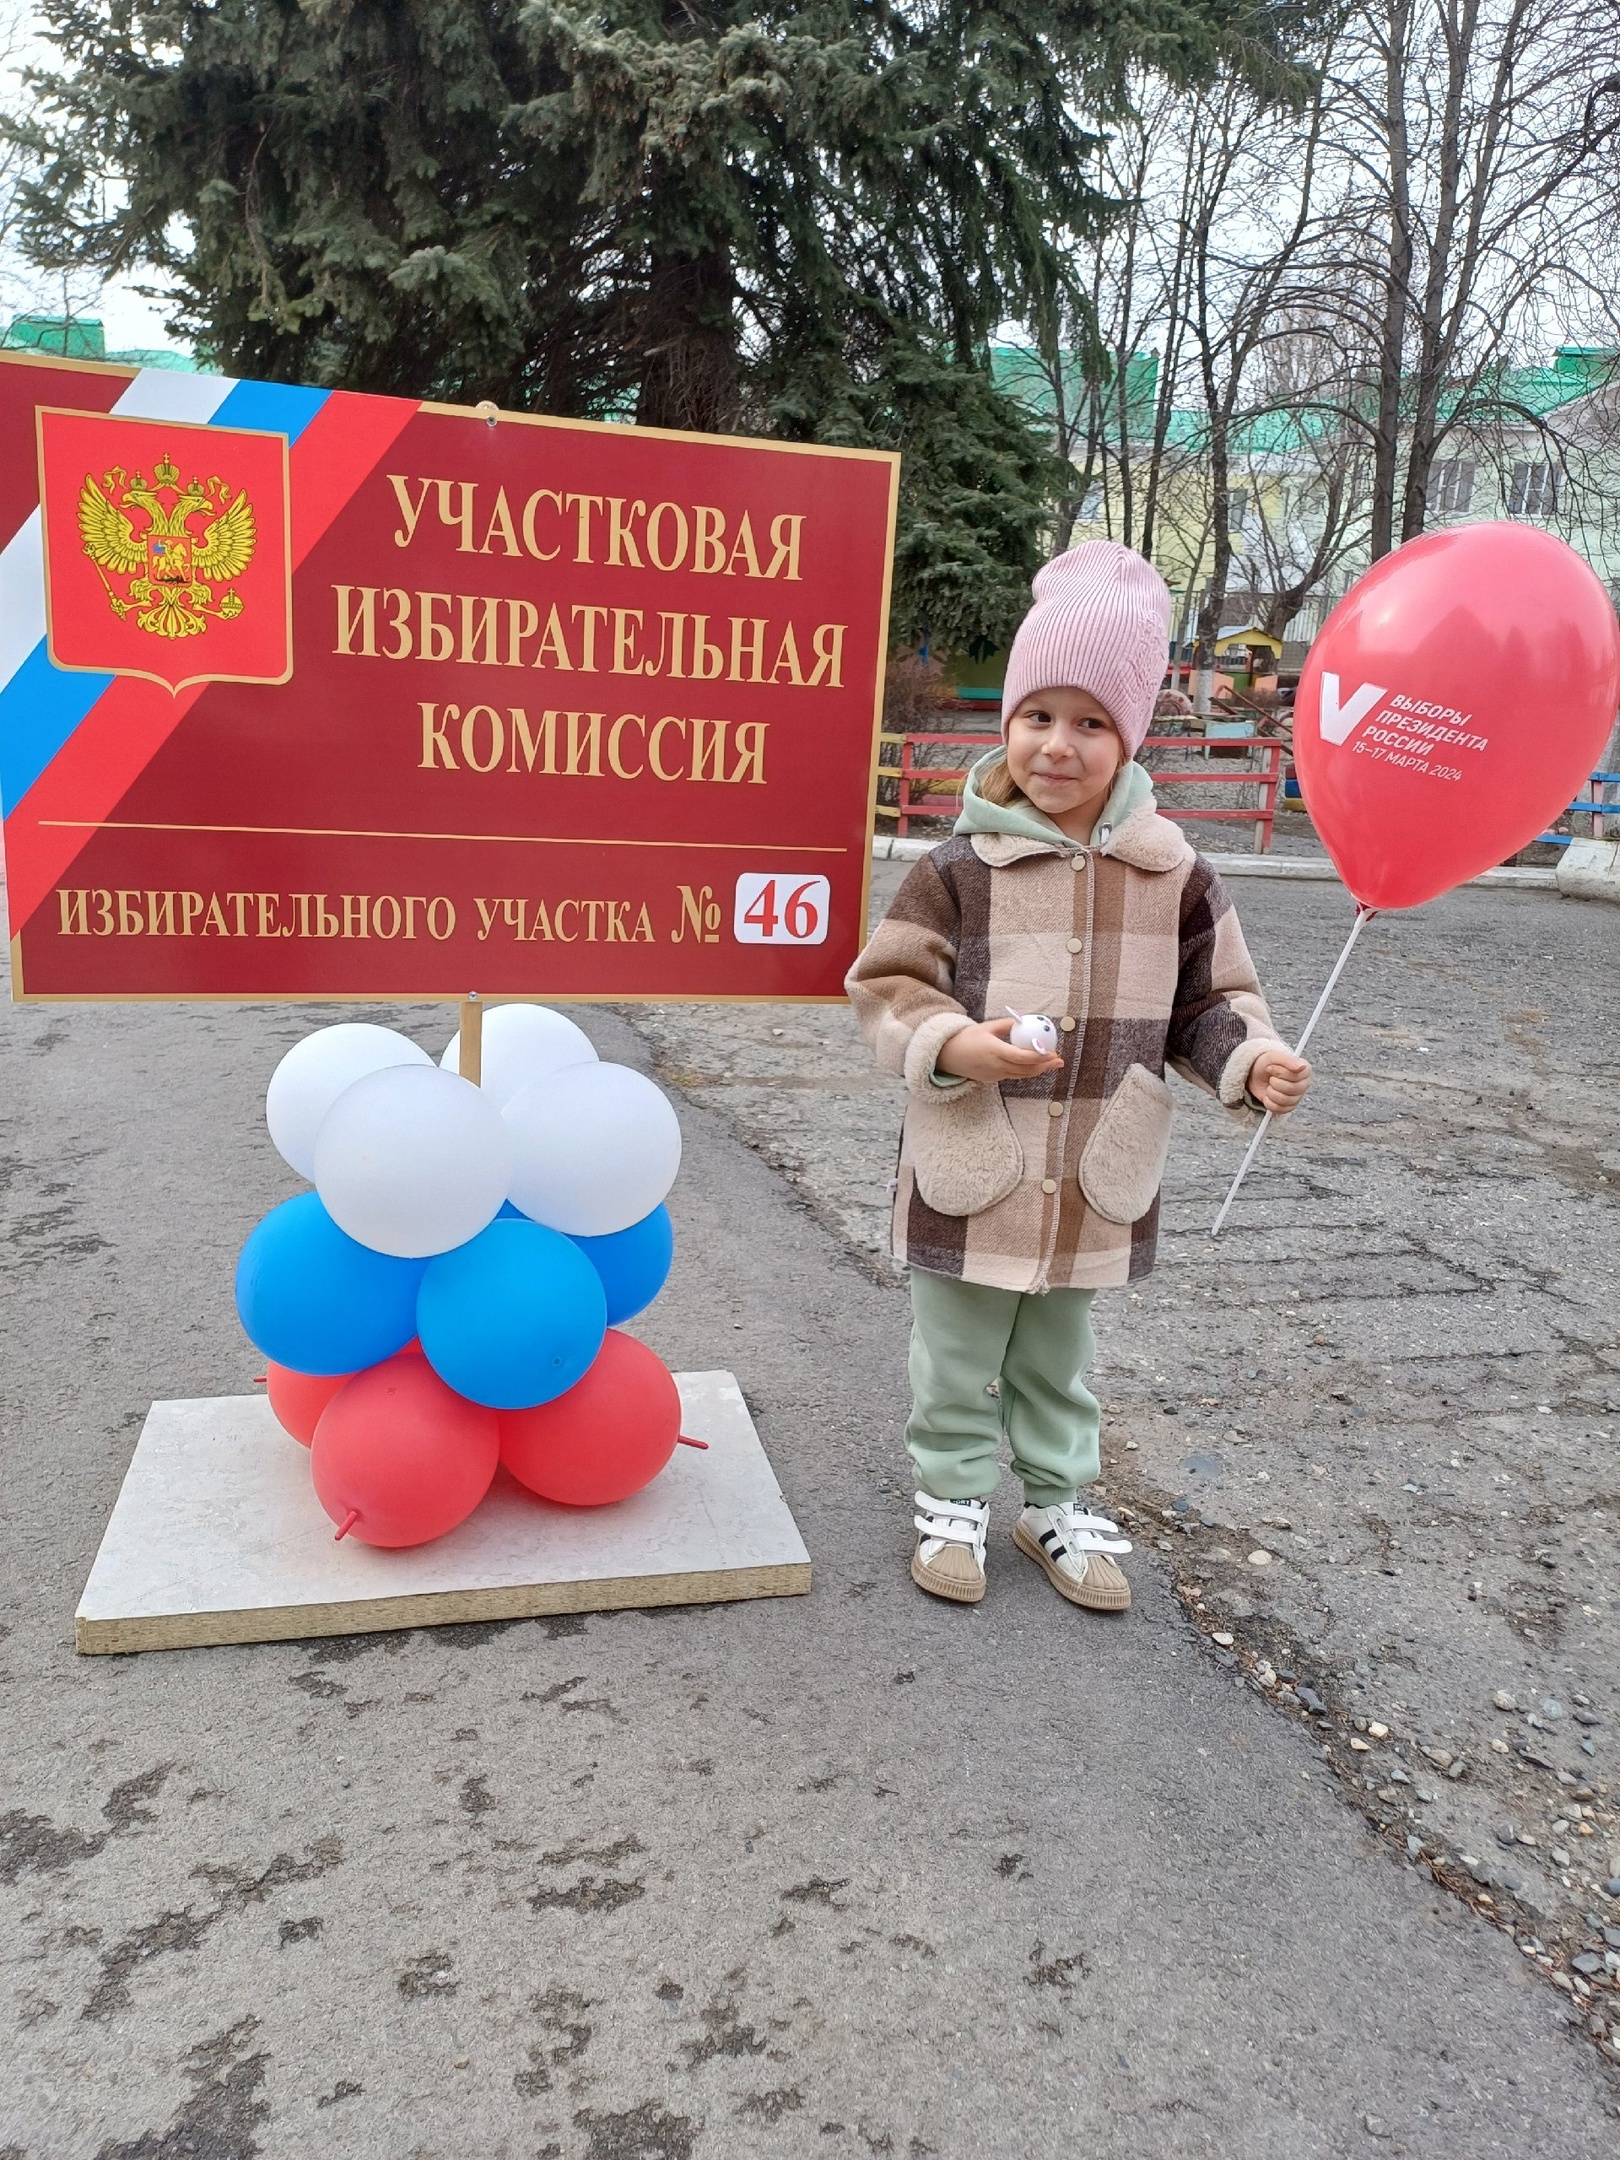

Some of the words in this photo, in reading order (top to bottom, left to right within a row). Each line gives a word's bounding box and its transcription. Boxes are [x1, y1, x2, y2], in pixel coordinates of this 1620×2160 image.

[386, 474, 807, 581] УЧАСТКОВАЯ
[331, 584, 849, 688] ИЗБИРАТЕЛЬНАЯ
[1375, 709, 1489, 751] ПРЕЗИДЕНТА
[1389, 694, 1473, 726] ВЫБОРЫ
[417, 702, 771, 784] КОМИССИЯ
[1361, 725, 1435, 756] РОССИИ
[1384, 751, 1430, 773] МАРТА
[1428, 764, 1463, 781] 2024
[56, 889, 456, 941] ИЗБИРАТЕЛЬНОГО
[474, 898, 655, 943] УЧАСТКА
[671, 885, 721, 943] №
[743, 879, 819, 939] 46
